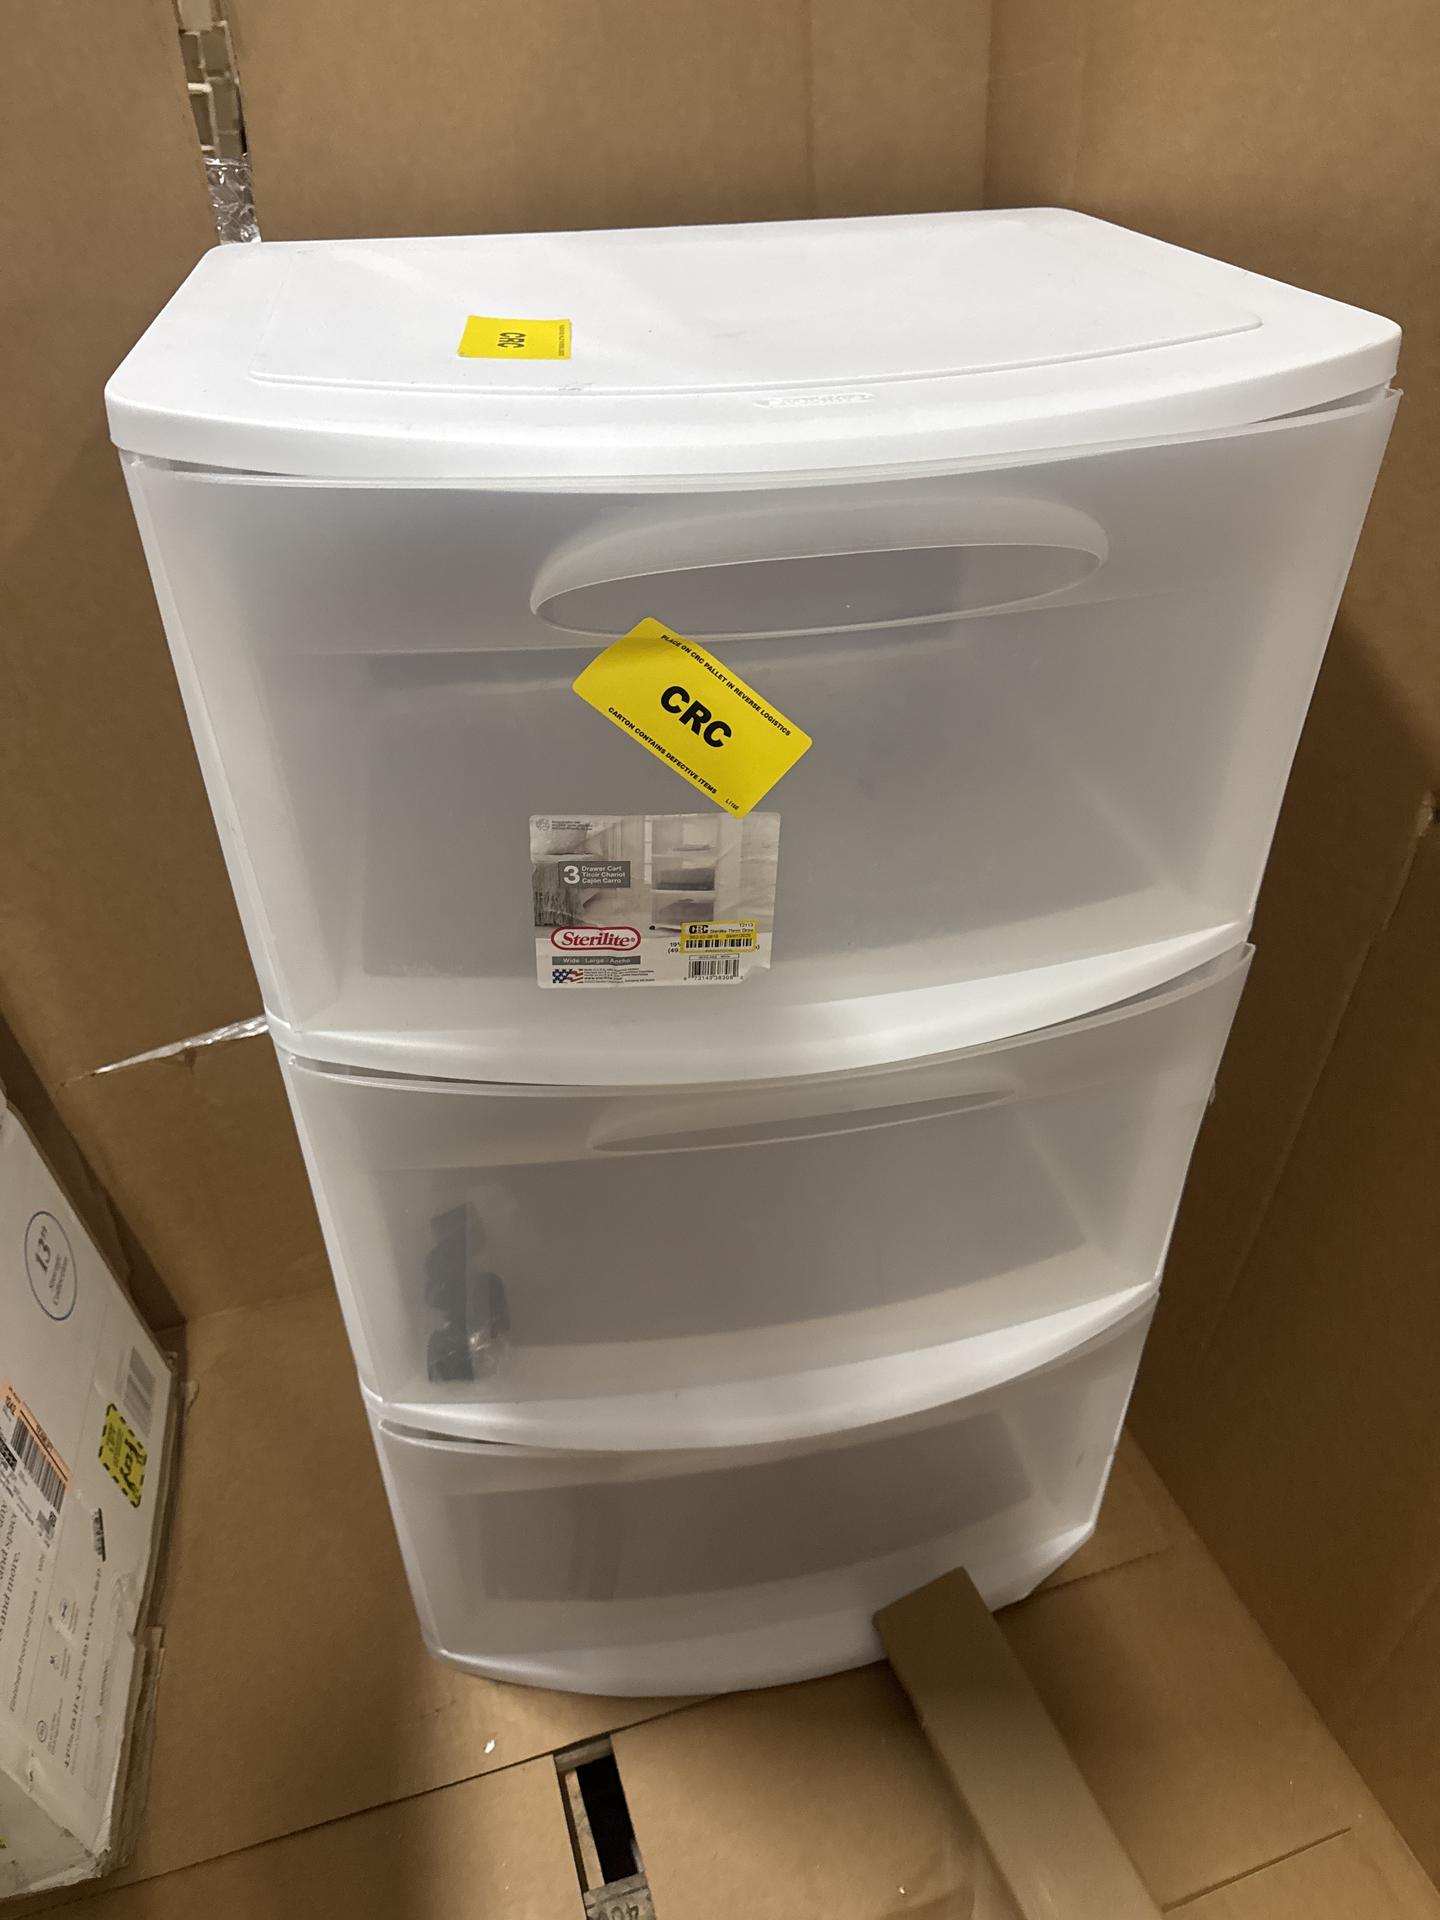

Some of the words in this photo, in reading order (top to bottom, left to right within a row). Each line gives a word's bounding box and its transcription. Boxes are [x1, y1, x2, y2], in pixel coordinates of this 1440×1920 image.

[497, 332, 527, 348] CRC
[660, 634, 682, 650] PLACE
[681, 643, 692, 656] ON
[690, 649, 705, 664] CRC
[704, 661, 728, 684] PALLET
[726, 680, 735, 690] IN
[734, 686, 761, 713] REVERSE
[760, 709, 792, 737] LOGISTICS
[660, 685, 732, 748] CRC
[608, 706, 636, 731] CARTON
[634, 727, 667, 757] CONTAINS
[665, 752, 700, 783] DEFECTIVE
[698, 777, 718, 795] ITEMS
[563, 865, 581, 885] 3
[561, 931, 630, 947] Sterilite
[585, 957, 604, 965] Large
[610, 957, 631, 965] Ancho
